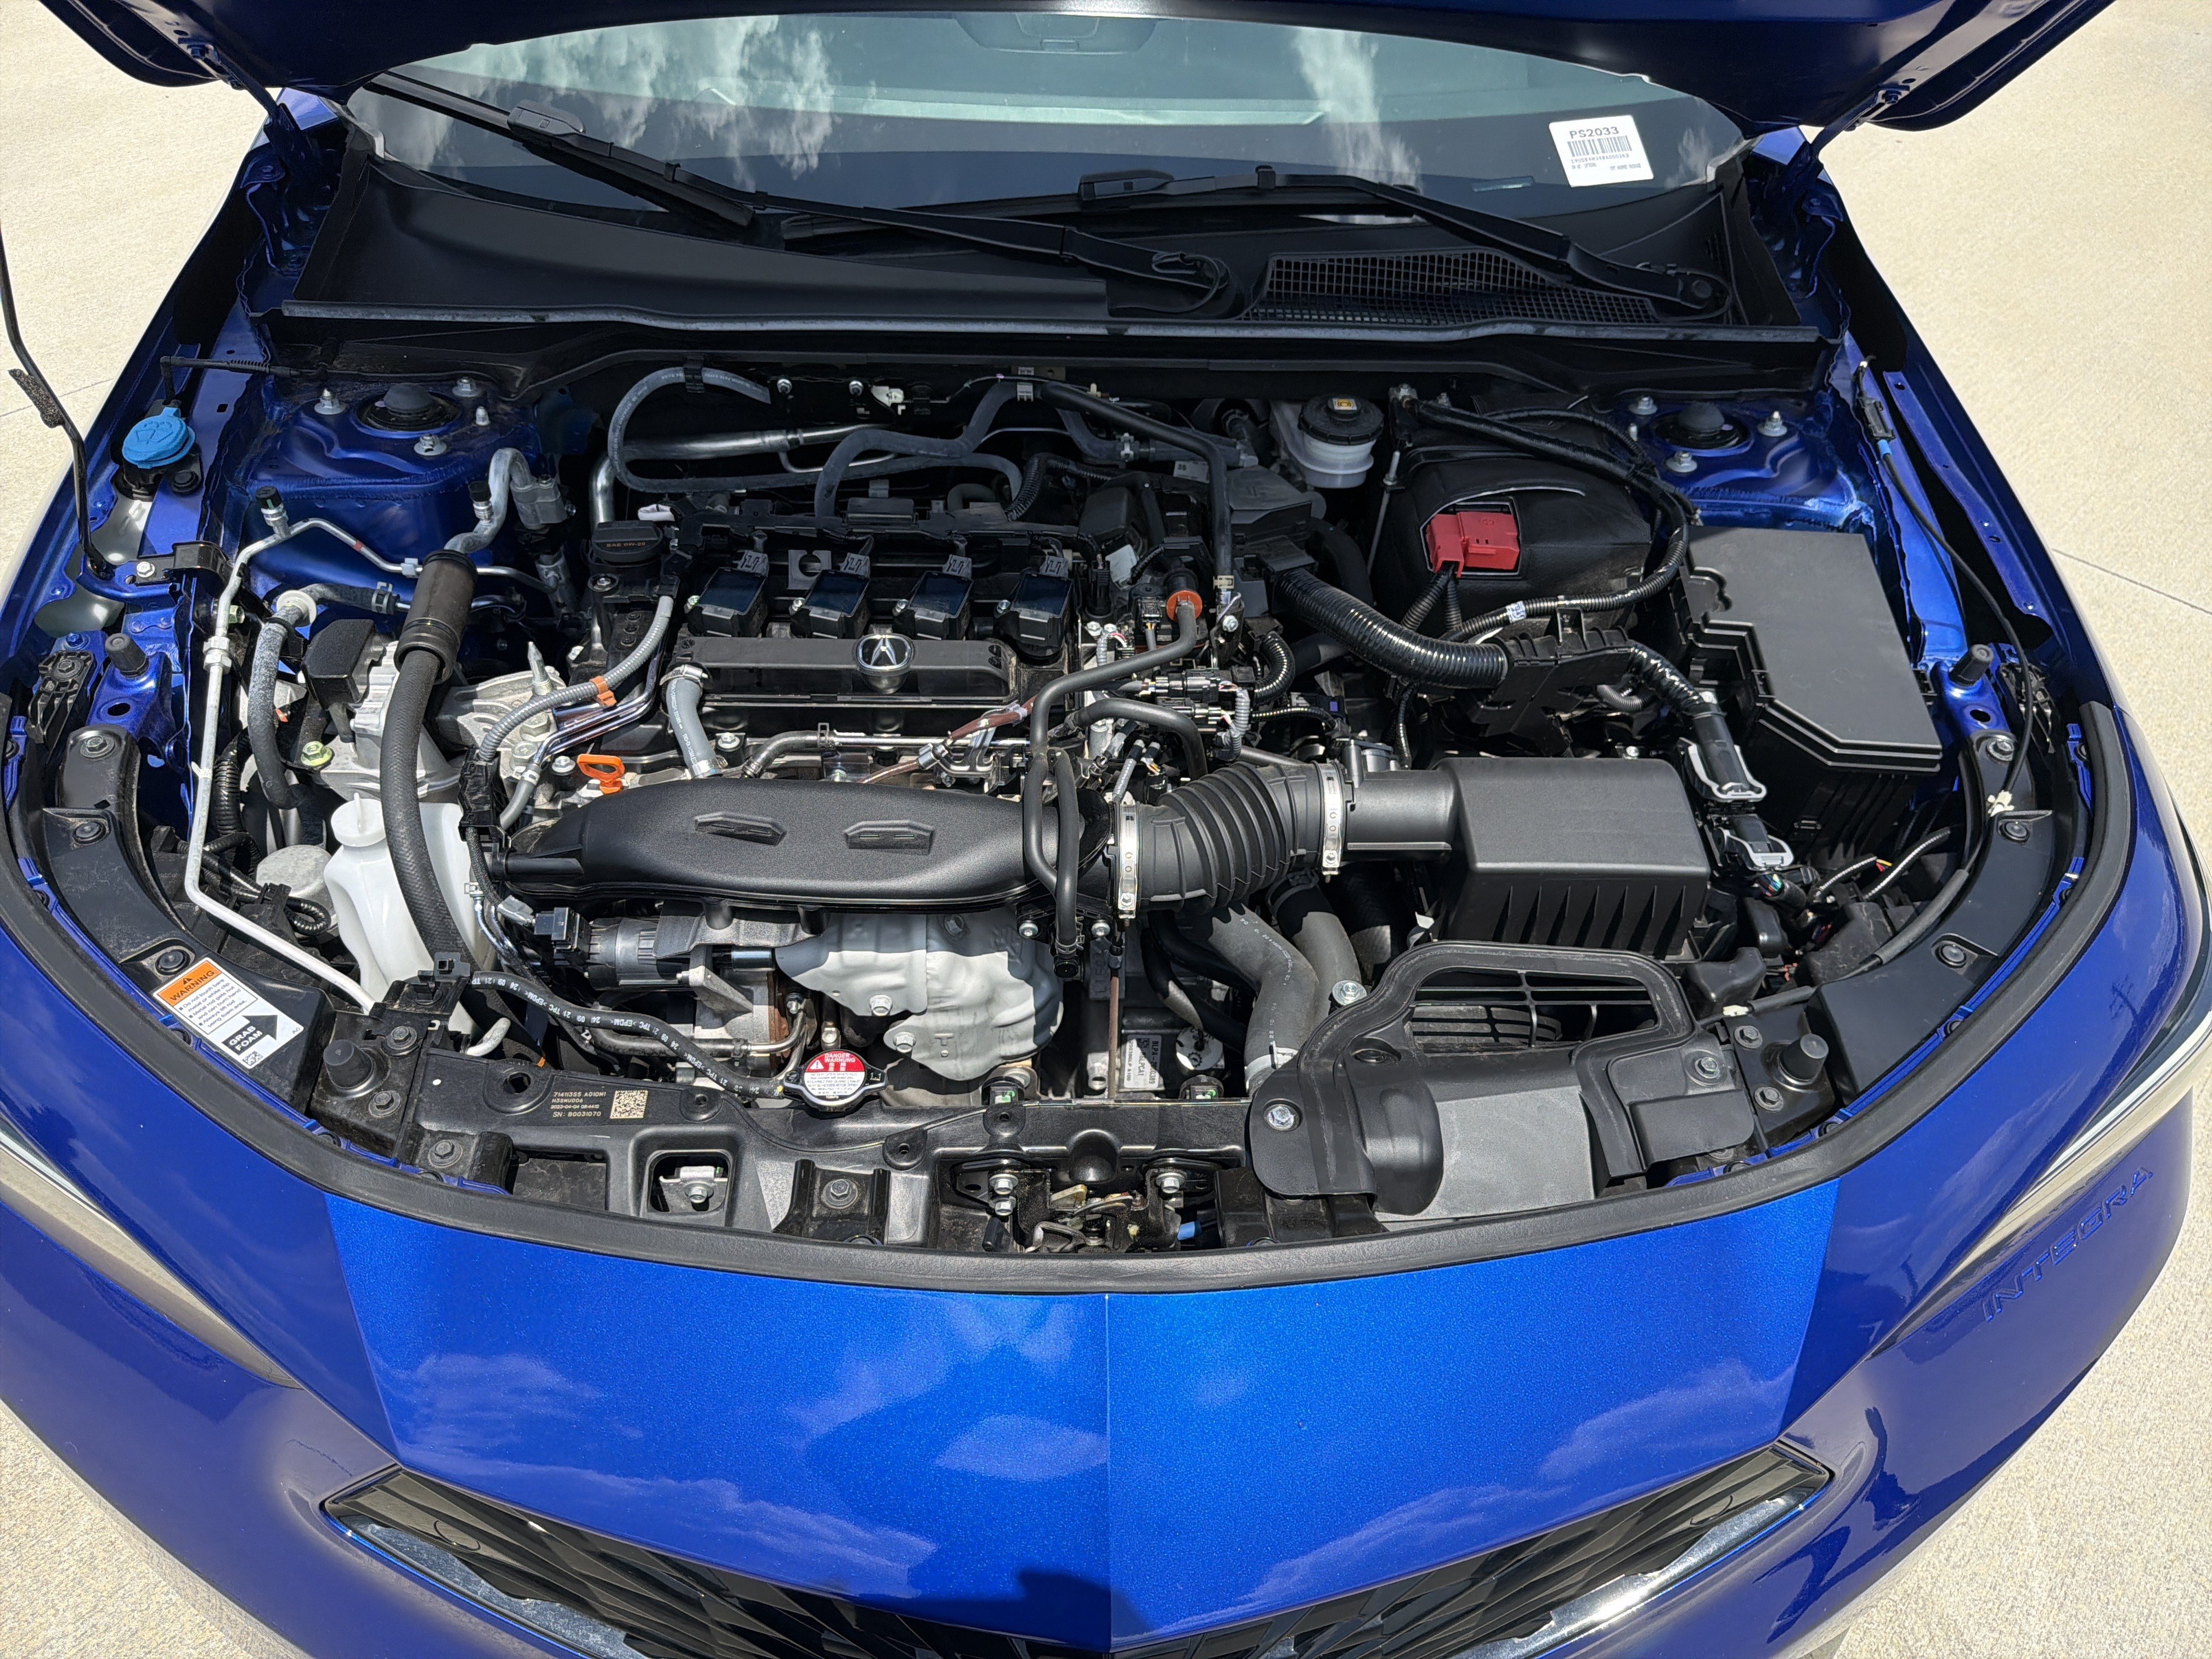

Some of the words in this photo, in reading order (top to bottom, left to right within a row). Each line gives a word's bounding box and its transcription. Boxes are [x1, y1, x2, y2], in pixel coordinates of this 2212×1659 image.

[1569, 126, 1620, 139] PS2033
[170, 969, 215, 1001] WARNING
[199, 986, 213, 996] touch
[509, 982, 519, 991] 24
[228, 989, 241, 997] hand
[524, 990, 548, 1006] >EPDM<
[188, 1002, 201, 1011] metal
[208, 989, 221, 997] white
[193, 1006, 206, 1014] Metal
[549, 1004, 561, 1015] TPC
[203, 1011, 221, 1023] Always
[208, 1017, 222, 1027] using
[222, 1008, 234, 1017] foam
[611, 1018, 636, 1027] >EPDM<
[639, 1021, 651, 1030] TPC
[229, 1025, 256, 1046] GRAB
[235, 1030, 263, 1051] FOAM
[662, 1033, 669, 1041] 09
[670, 1040, 679, 1050] 24
[683, 1052, 705, 1070] >EPDM<
[706, 1068, 718, 1080] TPC
[1982, 1167, 2153, 1322] INTEGRA
